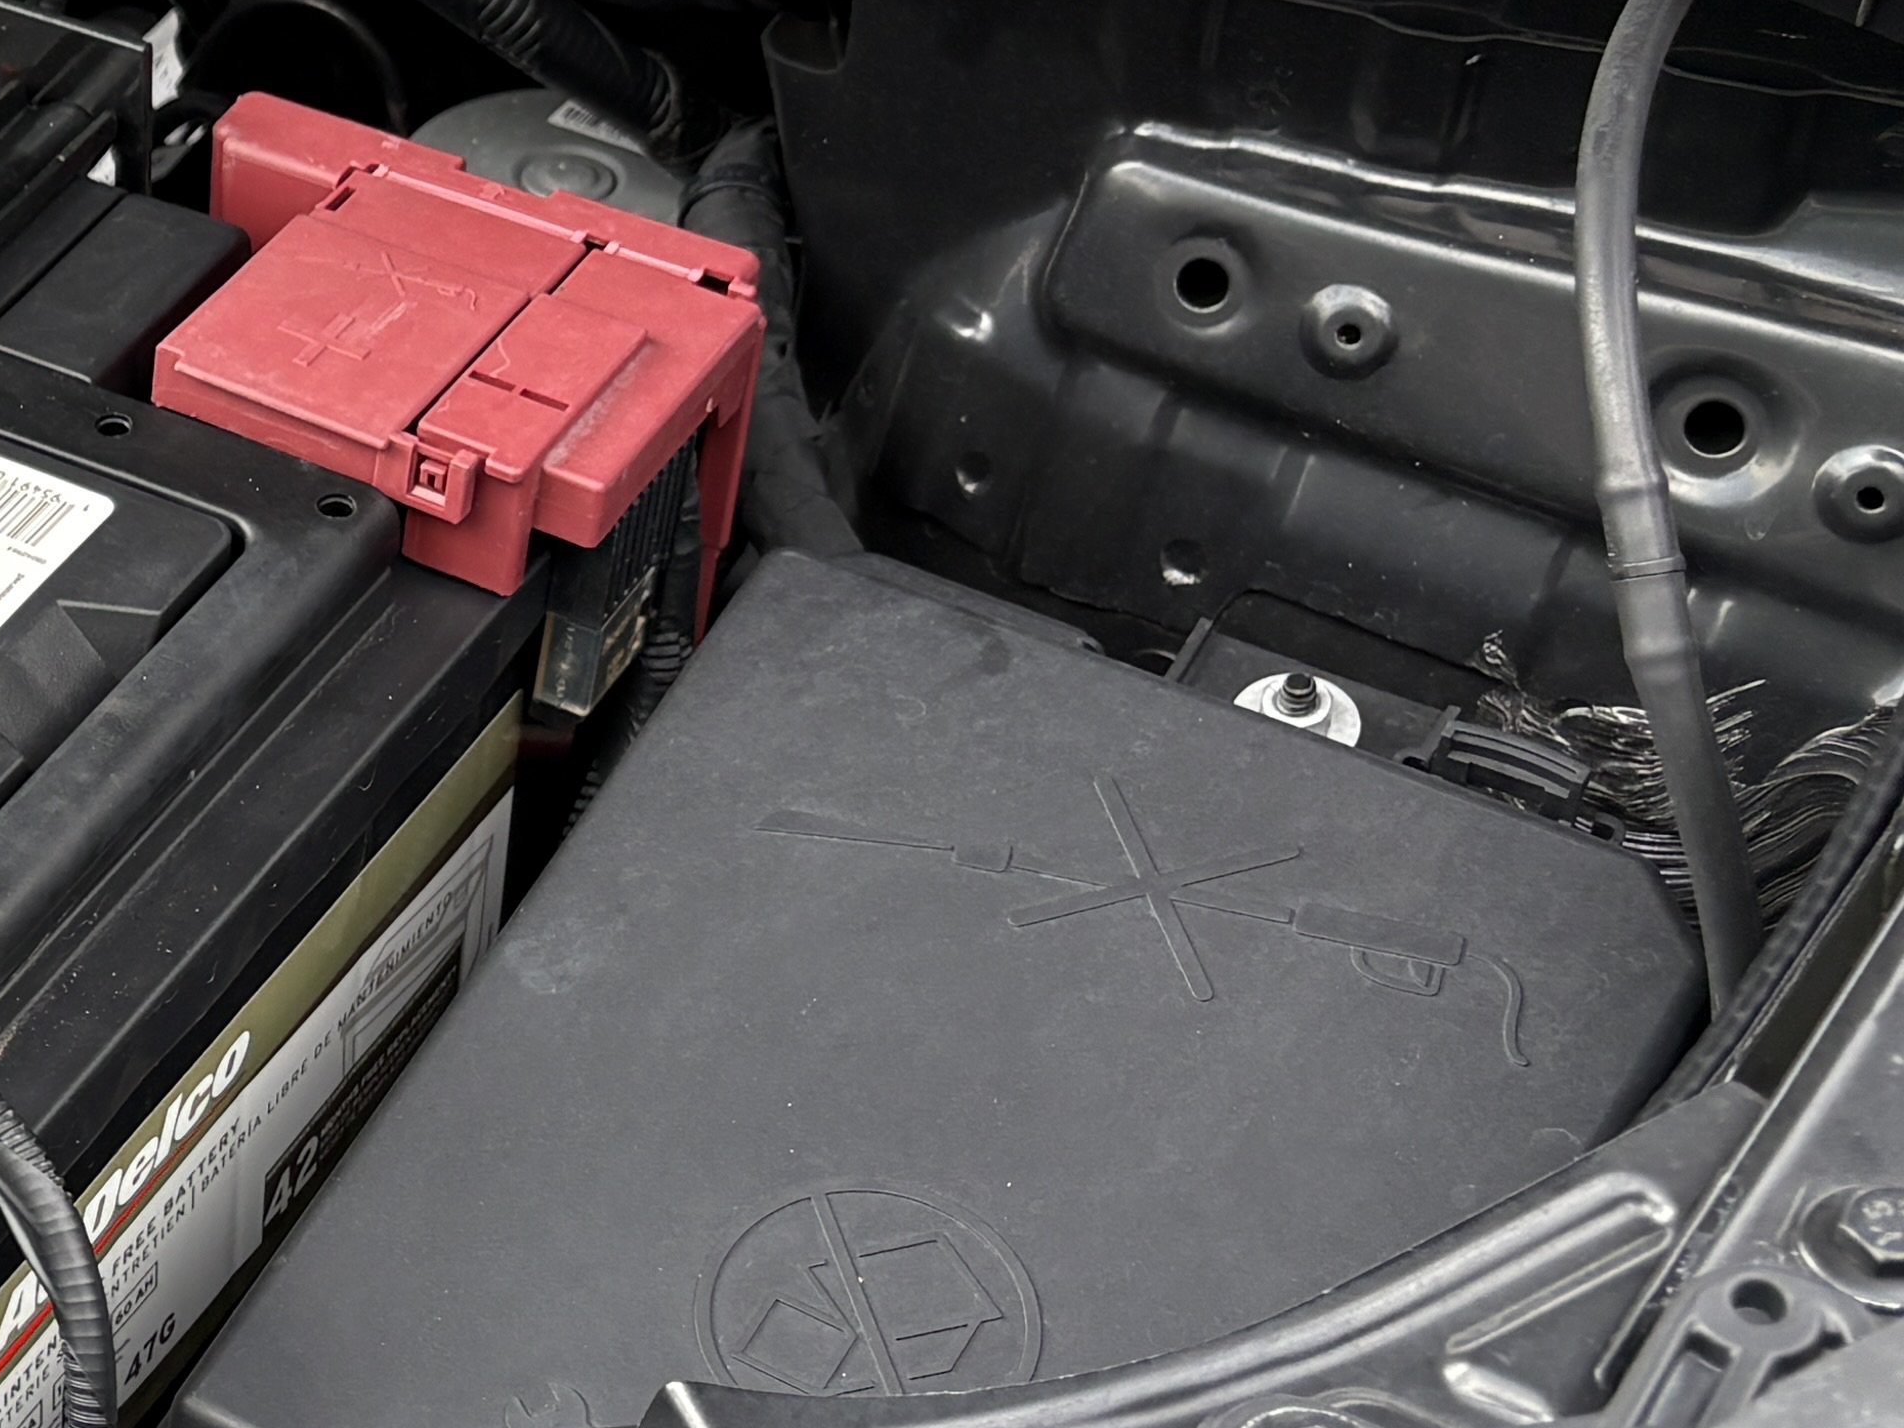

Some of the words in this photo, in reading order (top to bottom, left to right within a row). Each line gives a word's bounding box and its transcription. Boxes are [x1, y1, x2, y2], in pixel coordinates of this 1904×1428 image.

[199, 1114, 262, 1193] BATERÍA
[266, 1056, 308, 1115] LIBRE
[313, 1029, 332, 1060] DE
[336, 886, 453, 1035] MANTENIMIENTO
[111, 1215, 156, 1278] FREE
[161, 1113, 241, 1220] BATTERY
[261, 1135, 318, 1226] 42
[114, 1299, 133, 1325] 60
[134, 1273, 153, 1304] AH
[123, 1311, 176, 1386] 47G
